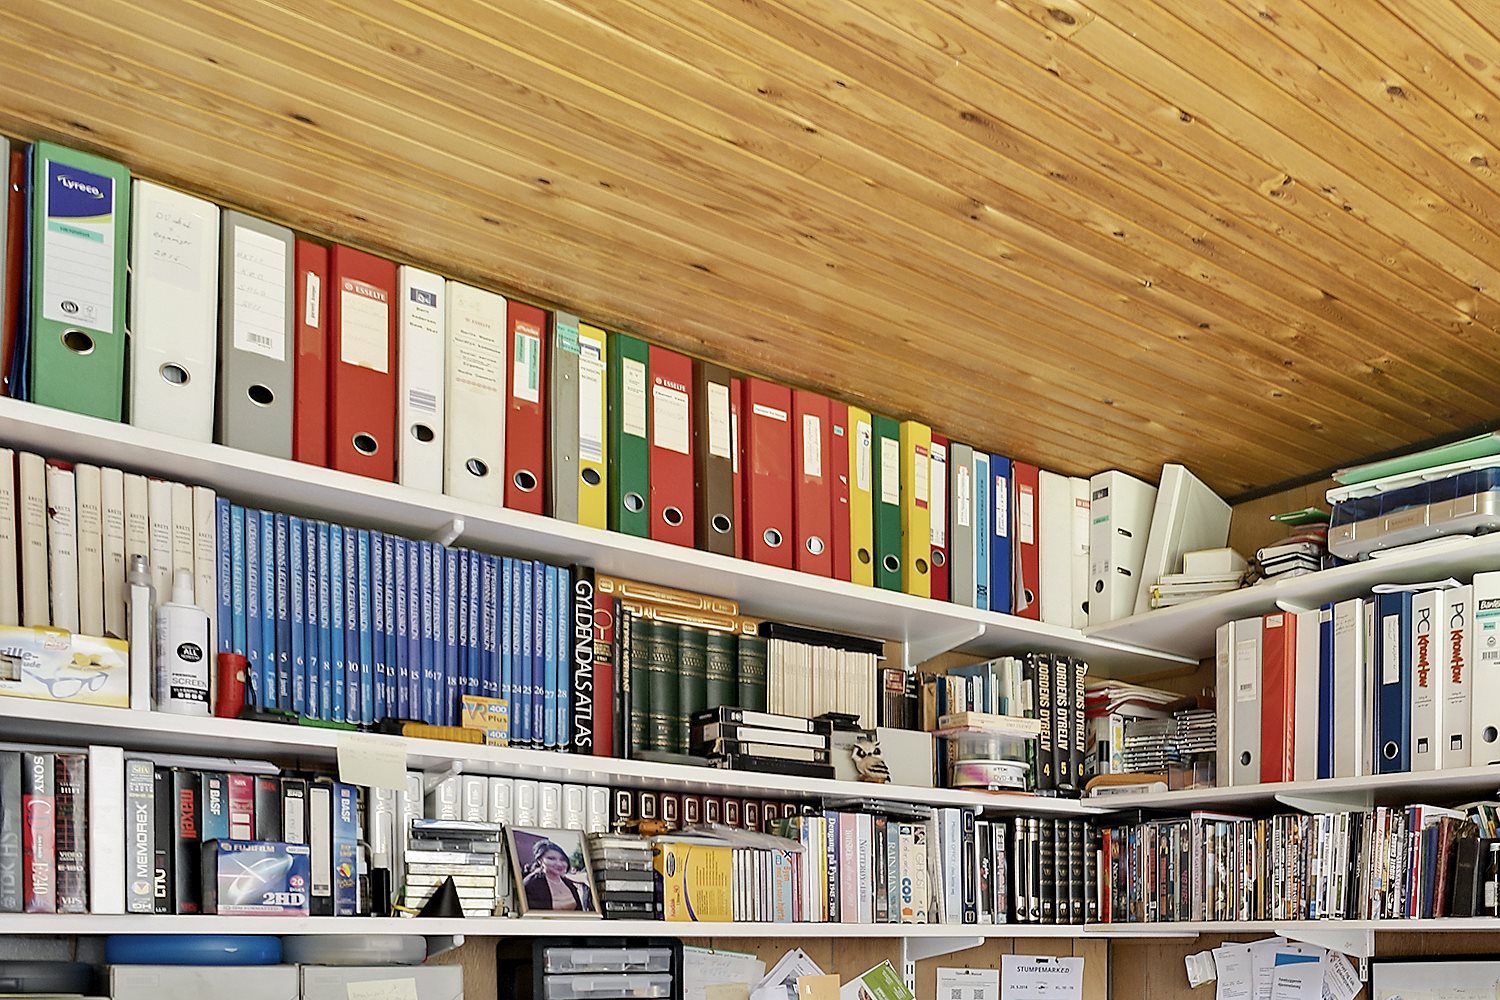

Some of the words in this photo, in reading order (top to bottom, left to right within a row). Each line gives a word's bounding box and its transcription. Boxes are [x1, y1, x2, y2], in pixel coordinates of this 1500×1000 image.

[61, 176, 101, 197] Lyreco
[355, 287, 386, 301] ESSELTE
[663, 379, 687, 392] ESSELTE
[1450, 603, 1464, 628] PC
[1417, 608, 1430, 634] PC
[575, 580, 593, 691] GYLDENDALS
[183, 647, 198, 656] ALL
[251, 651, 257, 660] 3
[268, 653, 274, 662] 4
[280, 653, 287, 662] 5
[297, 655, 303, 665] 6
[310, 657, 317, 665] 7
[323, 661, 330, 670] 8
[337, 661, 343, 669] 9
[348, 661, 358, 672] 10
[362, 663, 369, 673] 11
[376, 663, 385, 673] 12
[386, 666, 395, 676] 13
[411, 670, 419, 680] 15
[425, 669, 433, 679] 16
[433, 672, 442, 681] 17
[447, 676, 456, 686] 18
[459, 676, 467, 686] 19
[171, 677, 208, 687] SCREEN
[469, 677, 479, 687] 20
[1039, 661, 1050, 708] JORDENS
[1056, 661, 1067, 707] JORDENS
[1075, 663, 1089, 709] JORDENS
[512, 685, 522, 694] 24
[523, 685, 532, 694] 25
[535, 685, 544, 695] 26
[545, 690, 554, 699] 27
[558, 688, 567, 697] 28
[489, 705, 507, 713] 400
[488, 714, 507, 722] Plus
[575, 692, 592, 747] ATLAS
[1040, 709, 1051, 752] DYRELIV
[1057, 708, 1068, 750] DYRELIV
[1075, 710, 1085, 753] DYRELIV
[1043, 763, 1050, 777] 4
[1060, 762, 1067, 775] 5
[1078, 764, 1084, 777] 6
[34, 756, 44, 793] SONY
[209, 790, 221, 816] BASF
[180, 789, 197, 839] maxell
[341, 799, 351, 823] BASF
[828, 817, 837, 853] Dengang
[137, 803, 147, 878] MEMOREX
[233, 845, 275, 853] FUJIFILM
[291, 877, 303, 886] 20
[902, 877, 911, 904] COP
[61, 896, 82, 905] VHS
[262, 892, 306, 906] 2HD
[1016, 966, 1070, 974] STUMPEMARKED
